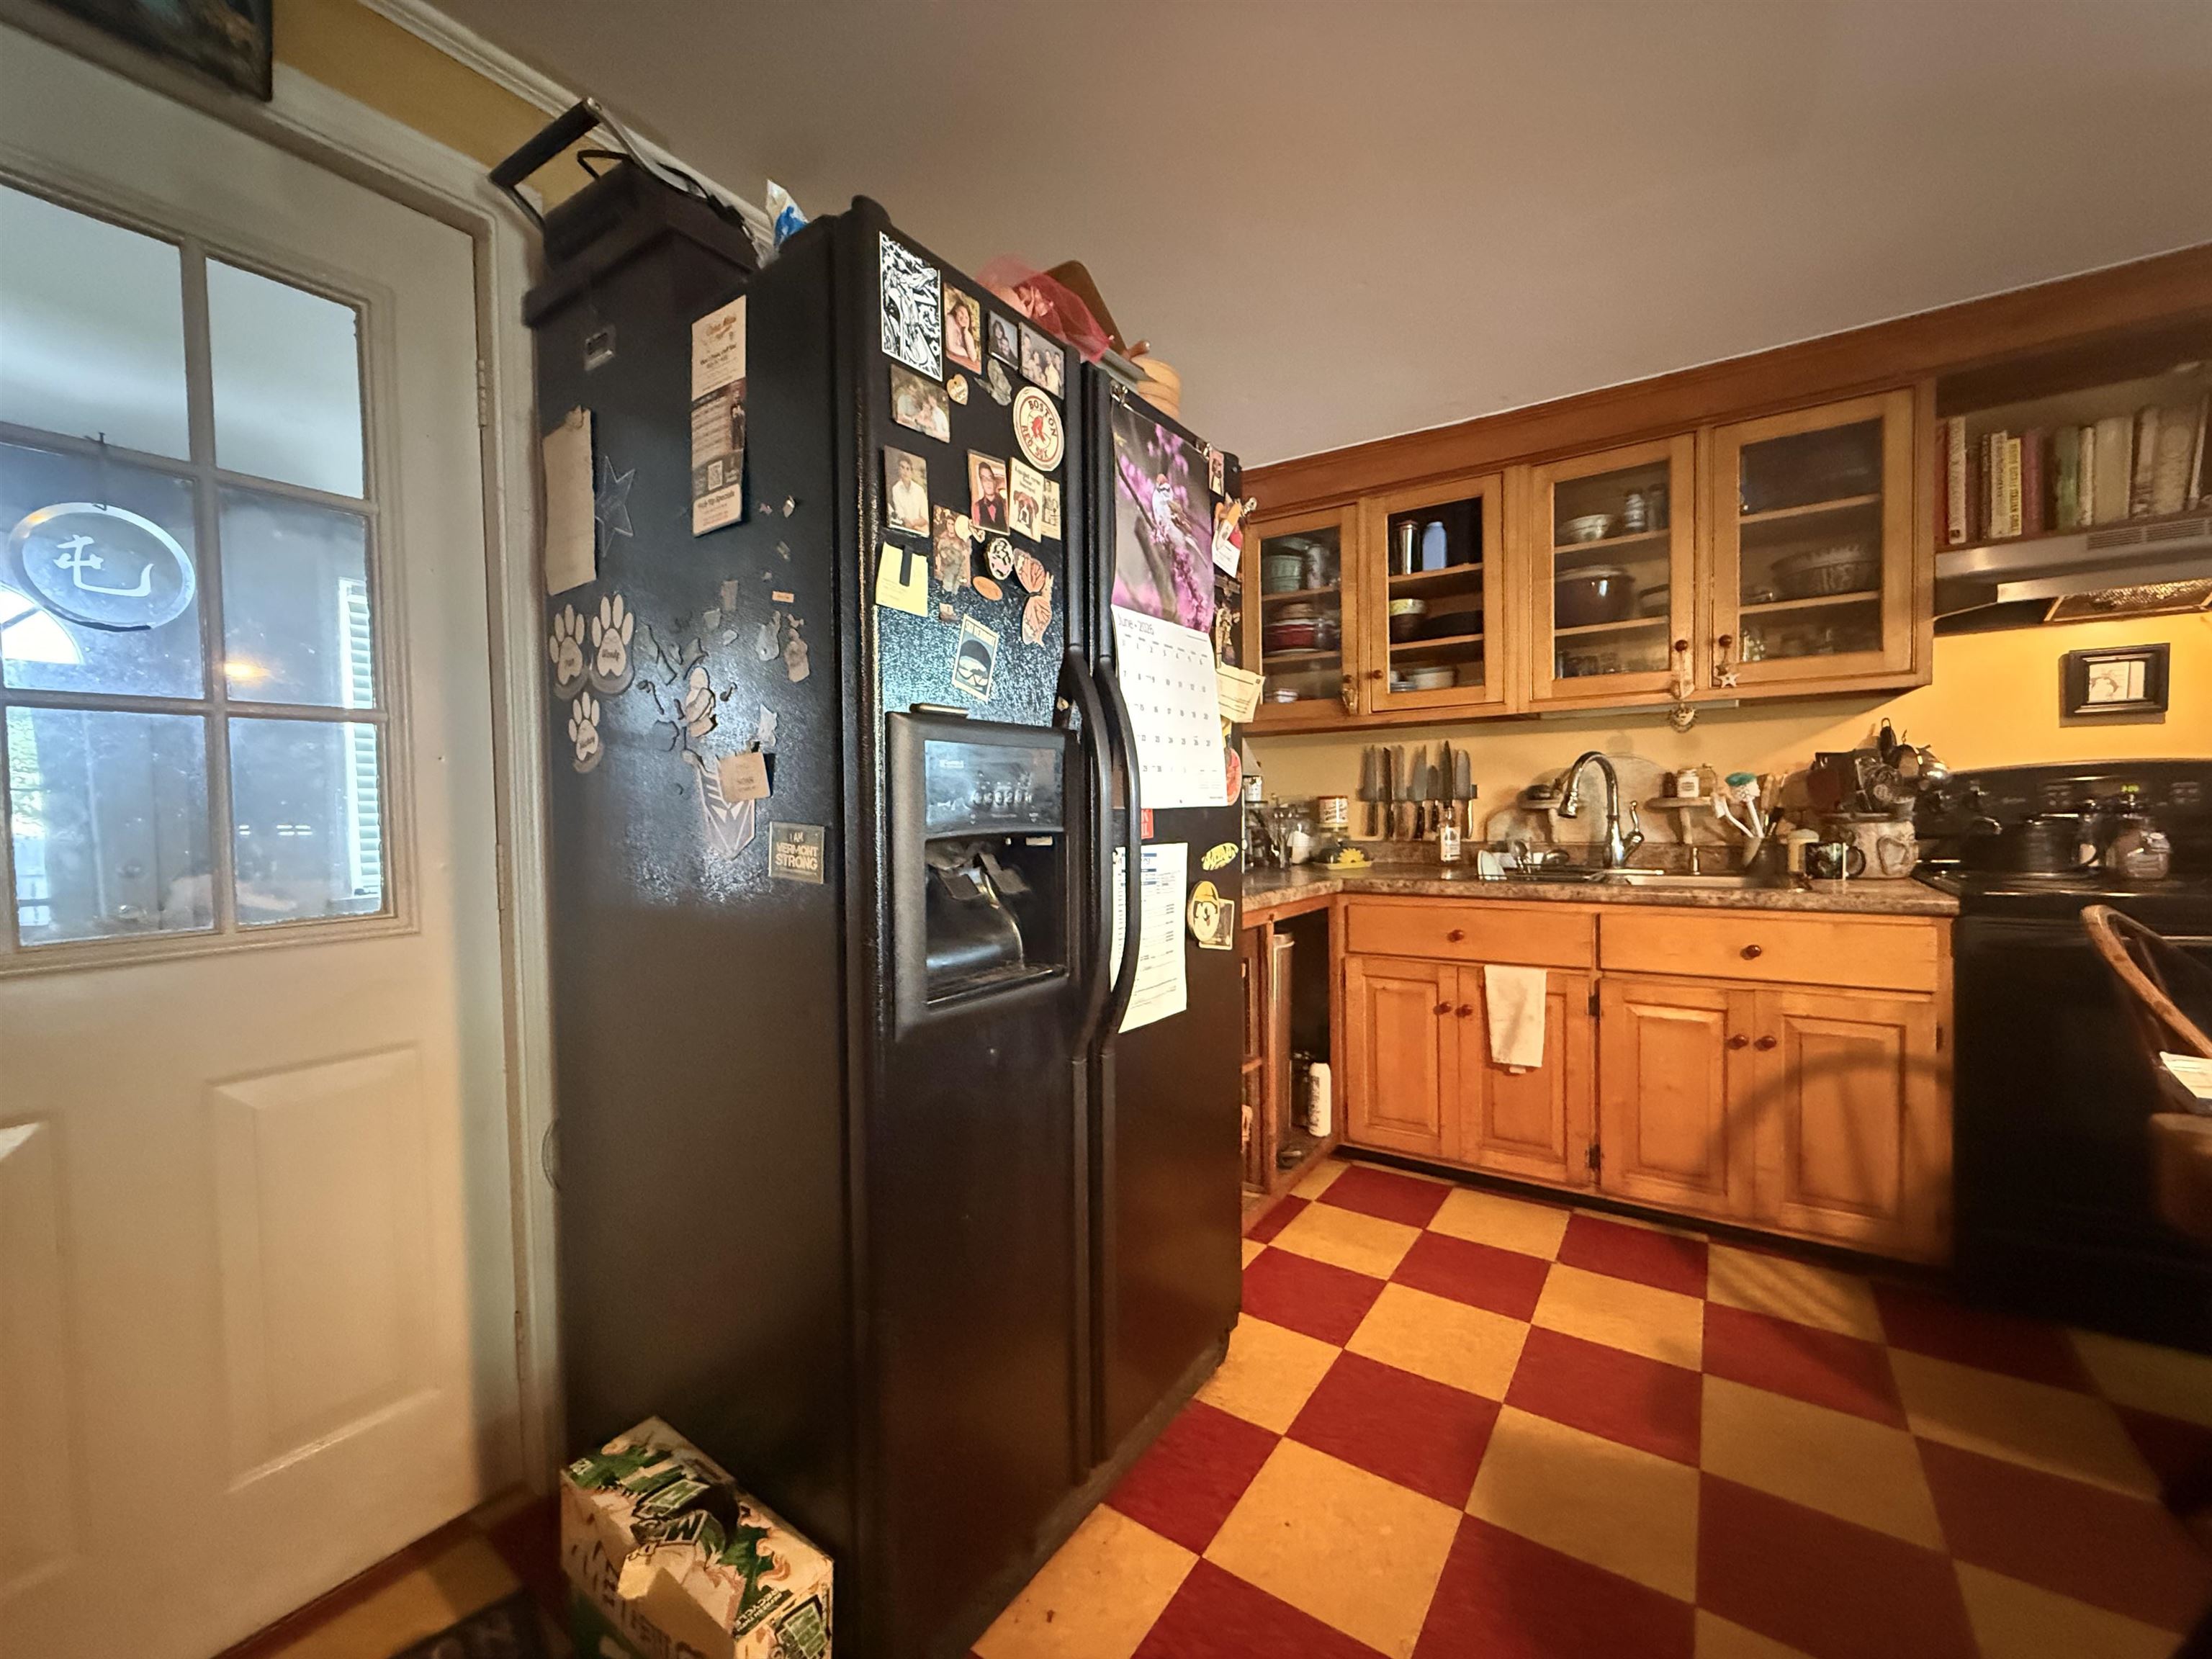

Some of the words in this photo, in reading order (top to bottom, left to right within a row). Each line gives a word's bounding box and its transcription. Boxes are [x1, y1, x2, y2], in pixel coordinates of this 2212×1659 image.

[1028, 400, 1057, 436] BOSTON
[1021, 425, 1033, 447] RED
[1118, 613, 1133, 629] June
[793, 832, 804, 842] AM
[776, 842, 819, 857] VERMONT
[775, 853, 818, 870] STRONG
[735, 1588, 779, 1625] RECYCLE
